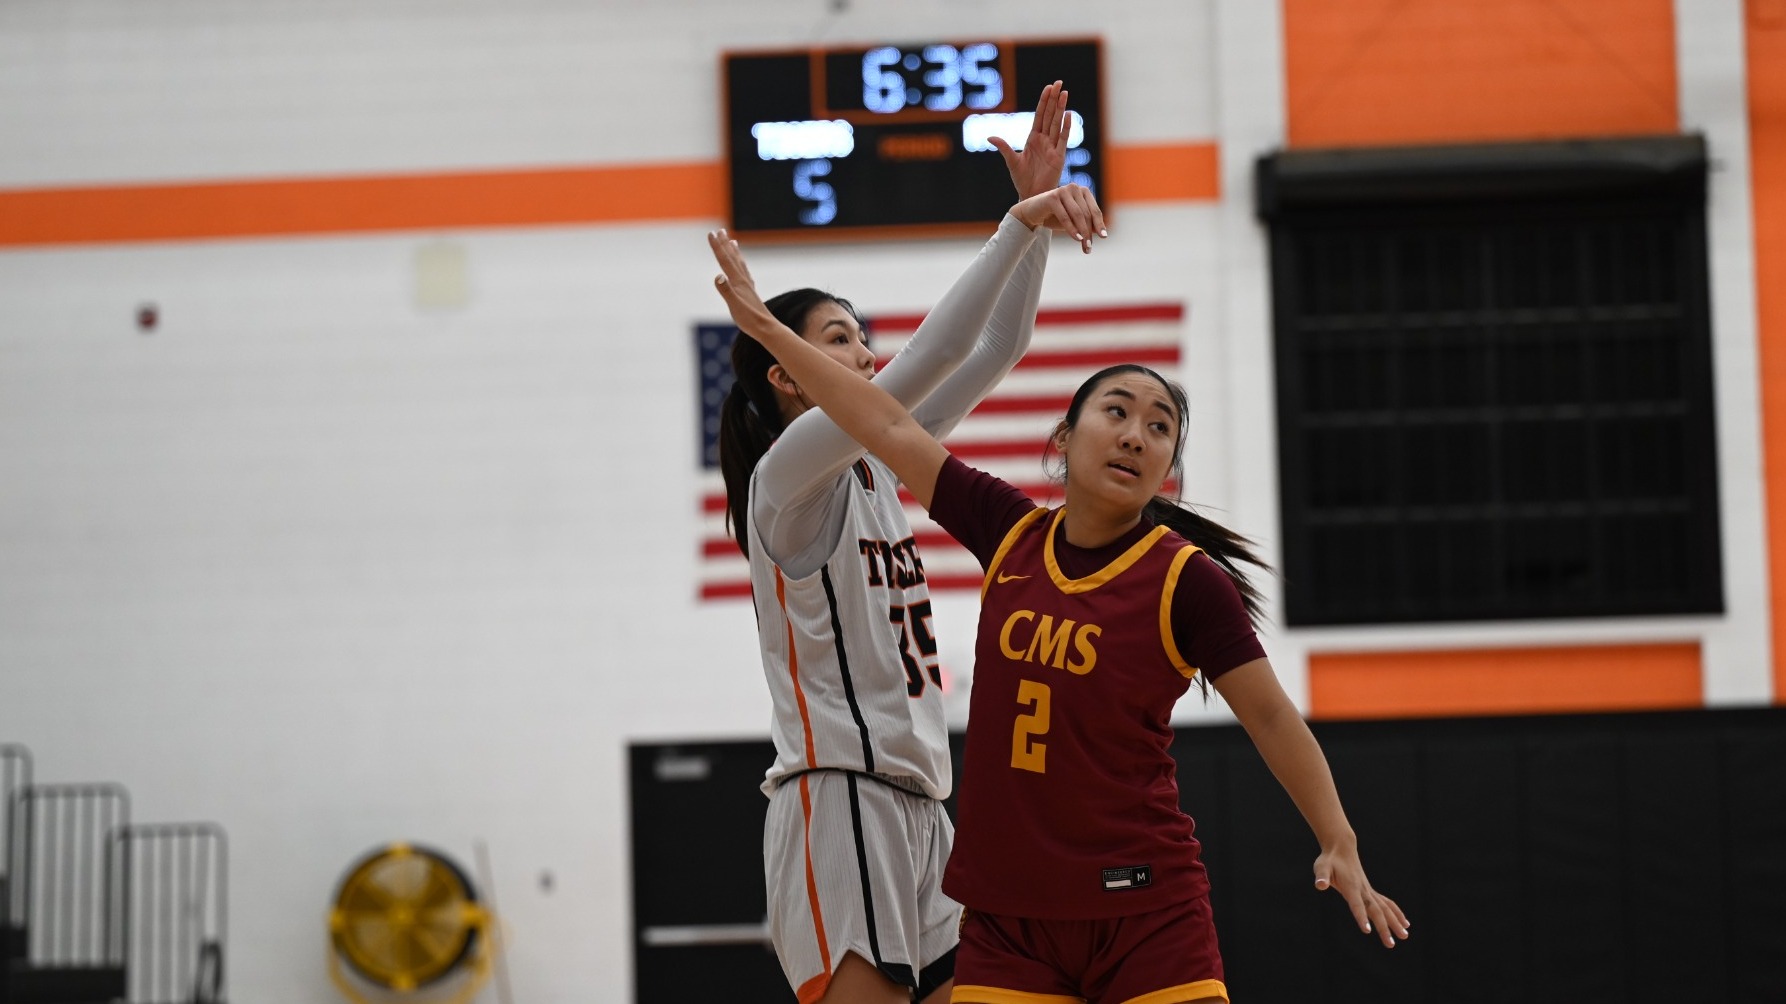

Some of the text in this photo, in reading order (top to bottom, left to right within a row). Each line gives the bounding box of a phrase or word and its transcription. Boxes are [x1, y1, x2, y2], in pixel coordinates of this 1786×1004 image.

[862, 43, 1003, 113] 6:35
[793, 158, 837, 225] 5
[1000, 609, 1102, 675] CMS
[1010, 679, 1051, 774] 2
[1137, 872, 1146, 882] M
